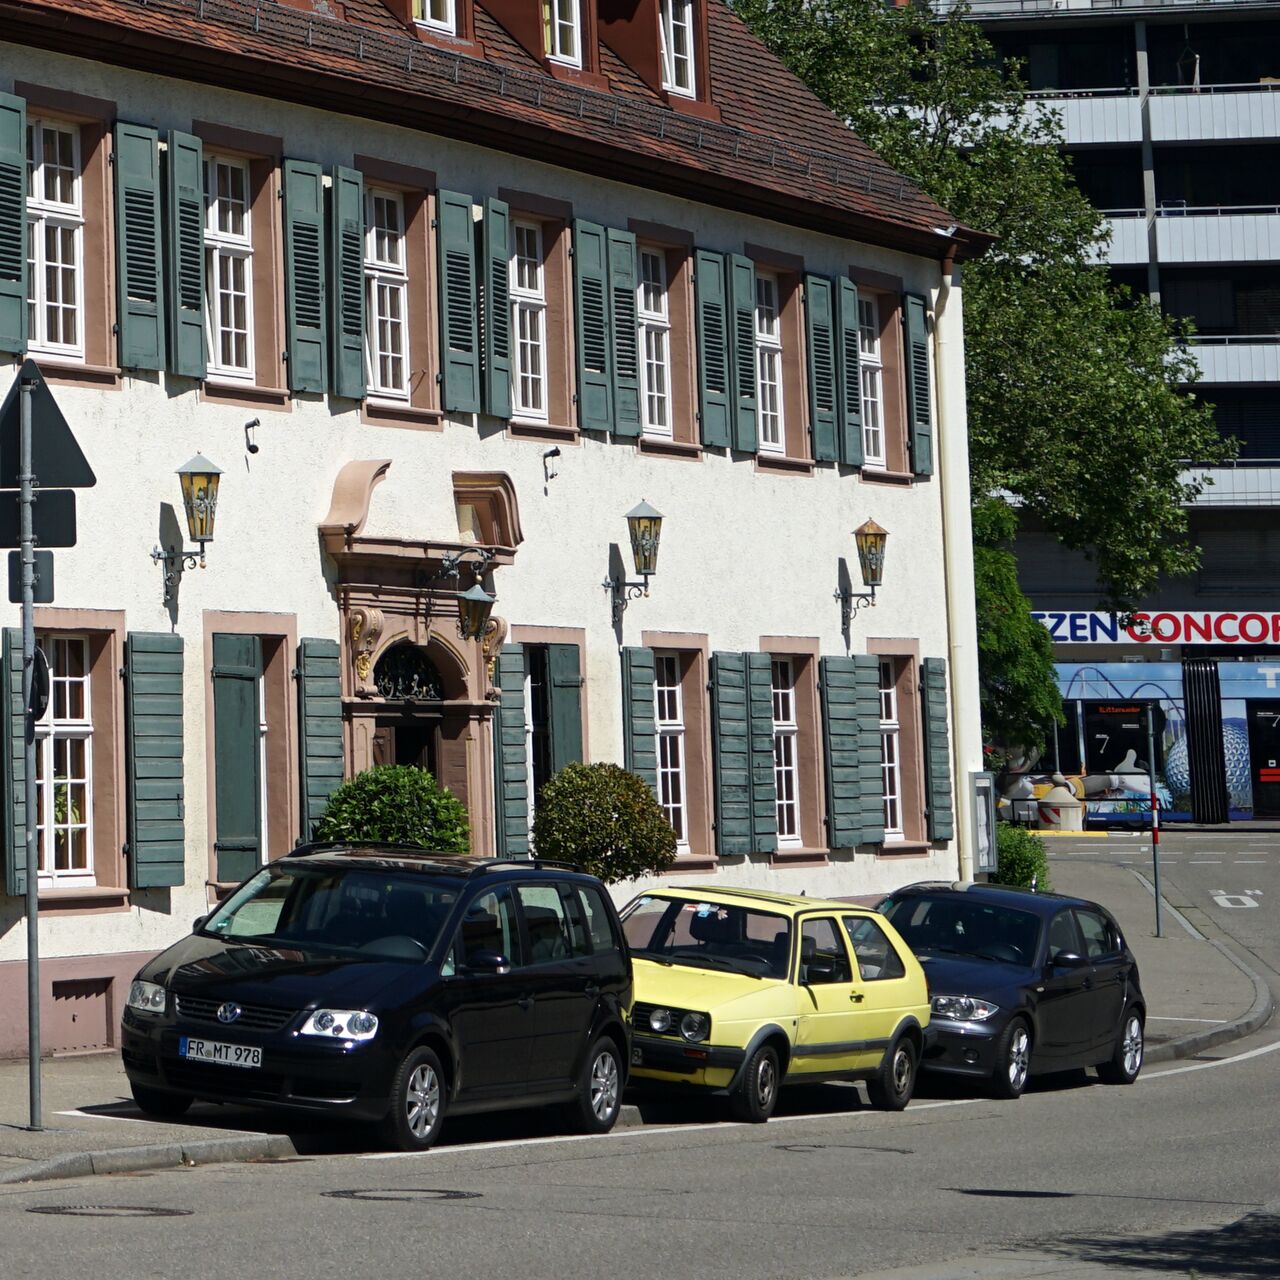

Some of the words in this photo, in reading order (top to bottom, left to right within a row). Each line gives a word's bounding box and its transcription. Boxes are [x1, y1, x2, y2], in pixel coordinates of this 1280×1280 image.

[187, 1040, 205, 1057] FR
[213, 1043, 231, 1060] MT
[234, 1047, 260, 1064] 978
